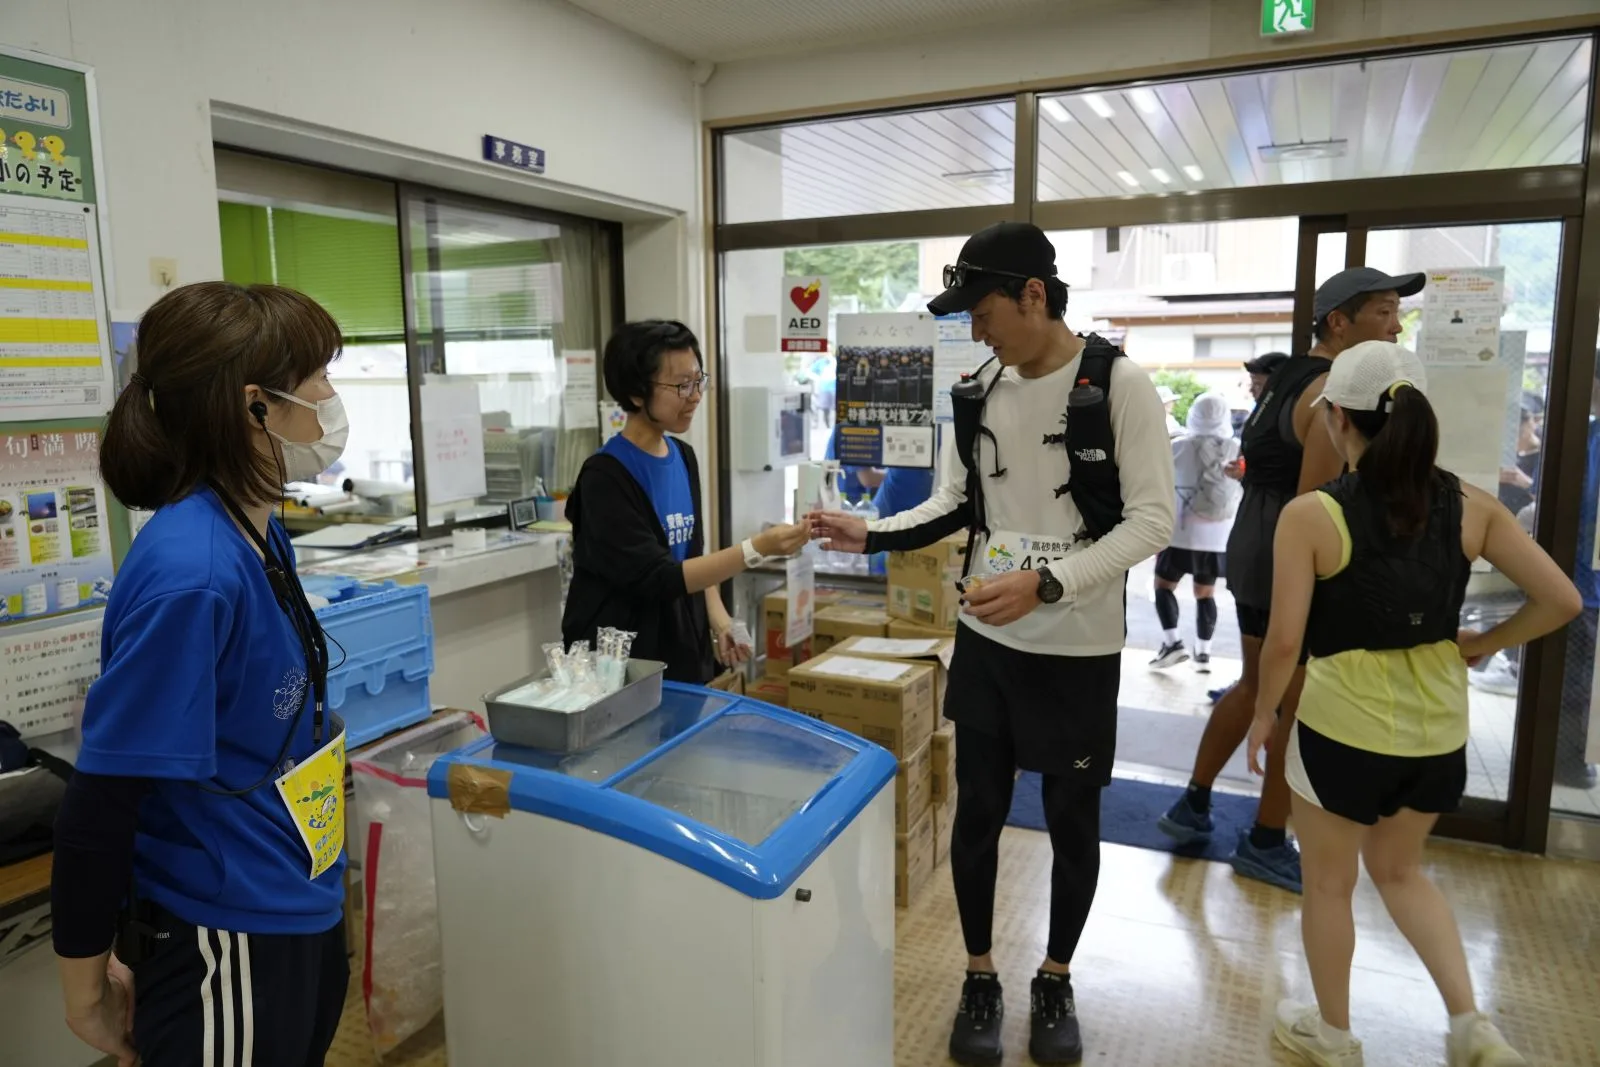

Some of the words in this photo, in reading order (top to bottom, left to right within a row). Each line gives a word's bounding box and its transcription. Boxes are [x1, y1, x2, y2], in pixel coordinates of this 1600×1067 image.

[0, 91, 56, 117] だより
[789, 317, 821, 329] AED
[1032, 541, 1071, 552] 高砂熱学
[790, 680, 817, 692] meiji
